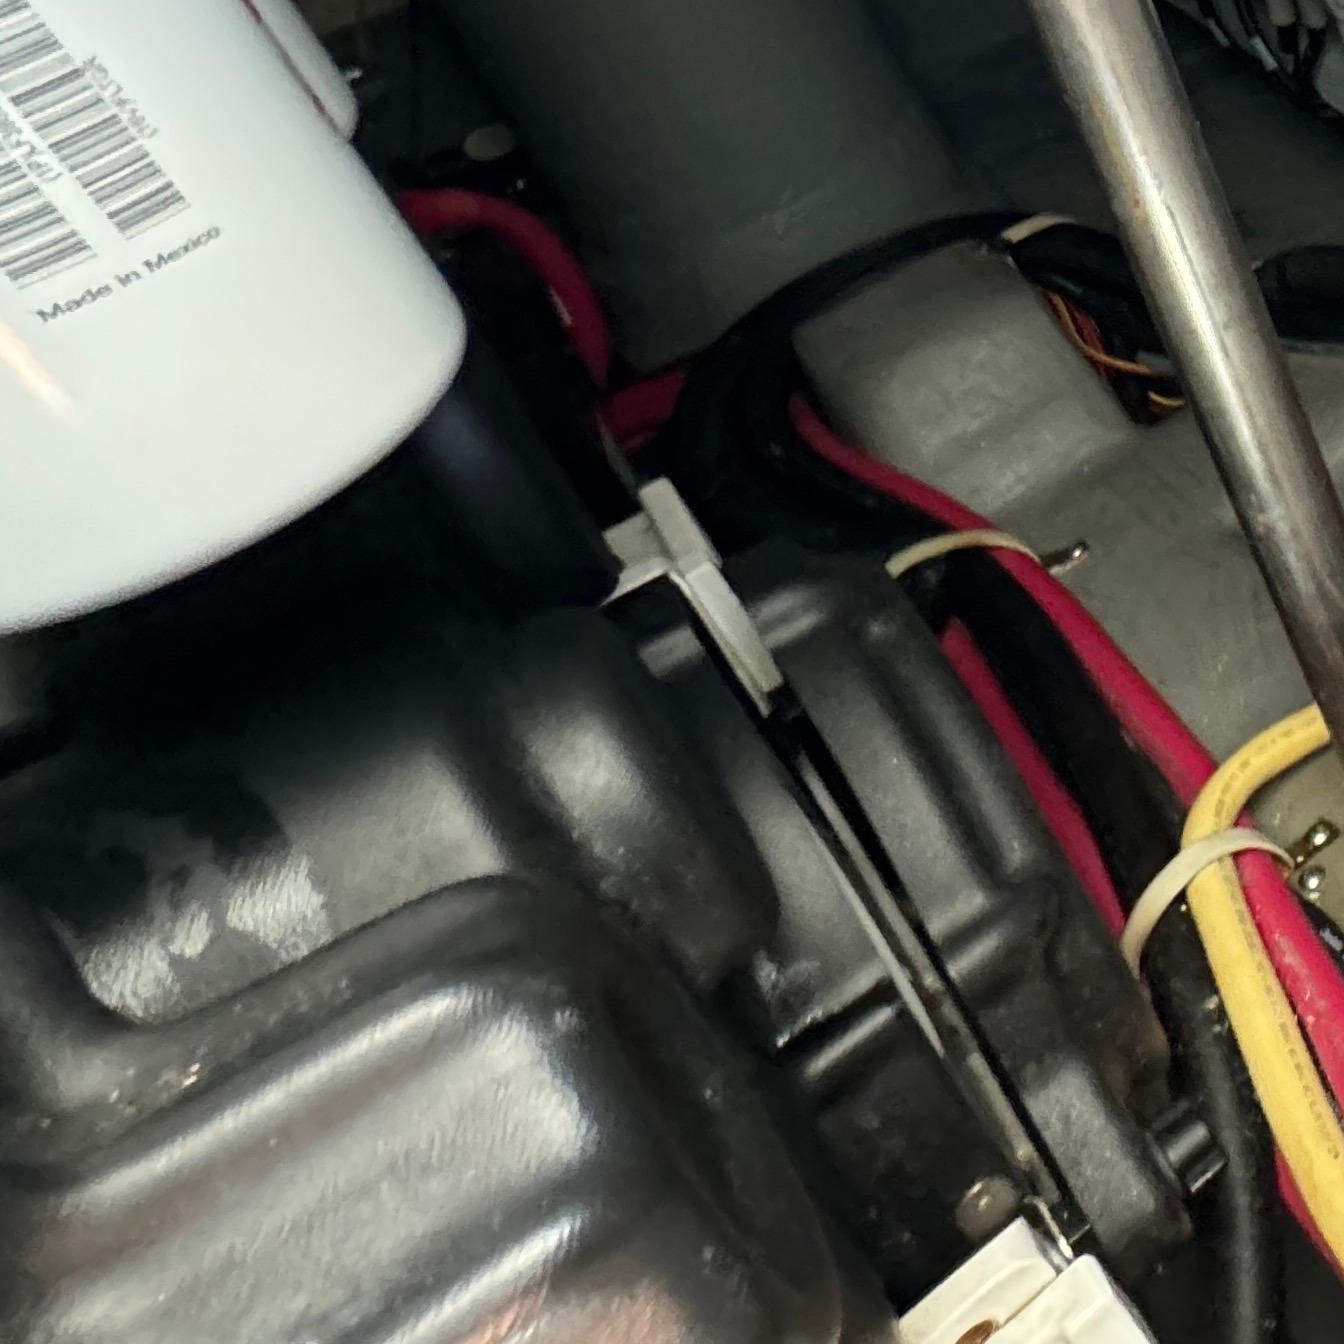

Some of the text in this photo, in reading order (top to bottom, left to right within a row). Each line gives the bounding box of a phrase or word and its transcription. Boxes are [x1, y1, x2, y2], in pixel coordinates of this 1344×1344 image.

[36, 225, 221, 323] Made in Mexico
